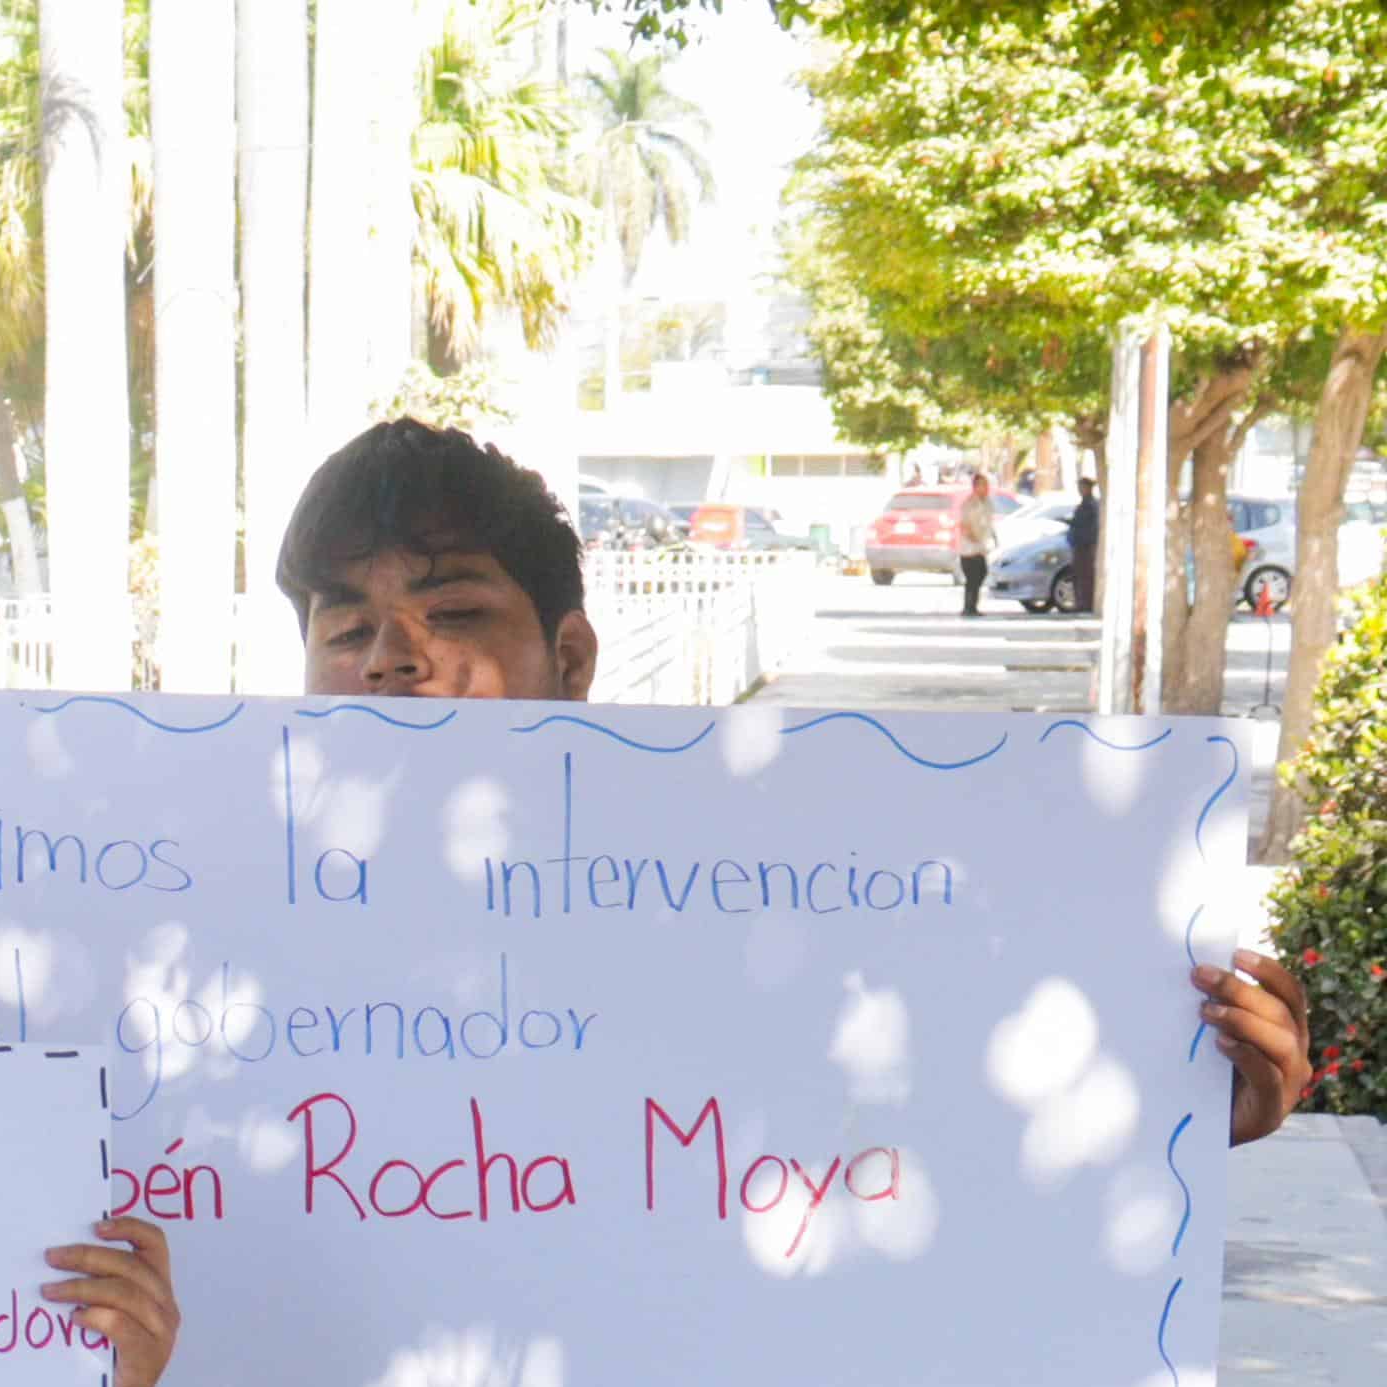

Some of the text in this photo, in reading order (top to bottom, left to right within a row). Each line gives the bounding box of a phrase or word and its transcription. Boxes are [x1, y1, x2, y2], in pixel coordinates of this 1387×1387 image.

[281, 725, 368, 904] la
[109, 952, 597, 1120] gobernador
[287, 1091, 575, 1222] Rocha
[644, 1095, 899, 1259] Moya
